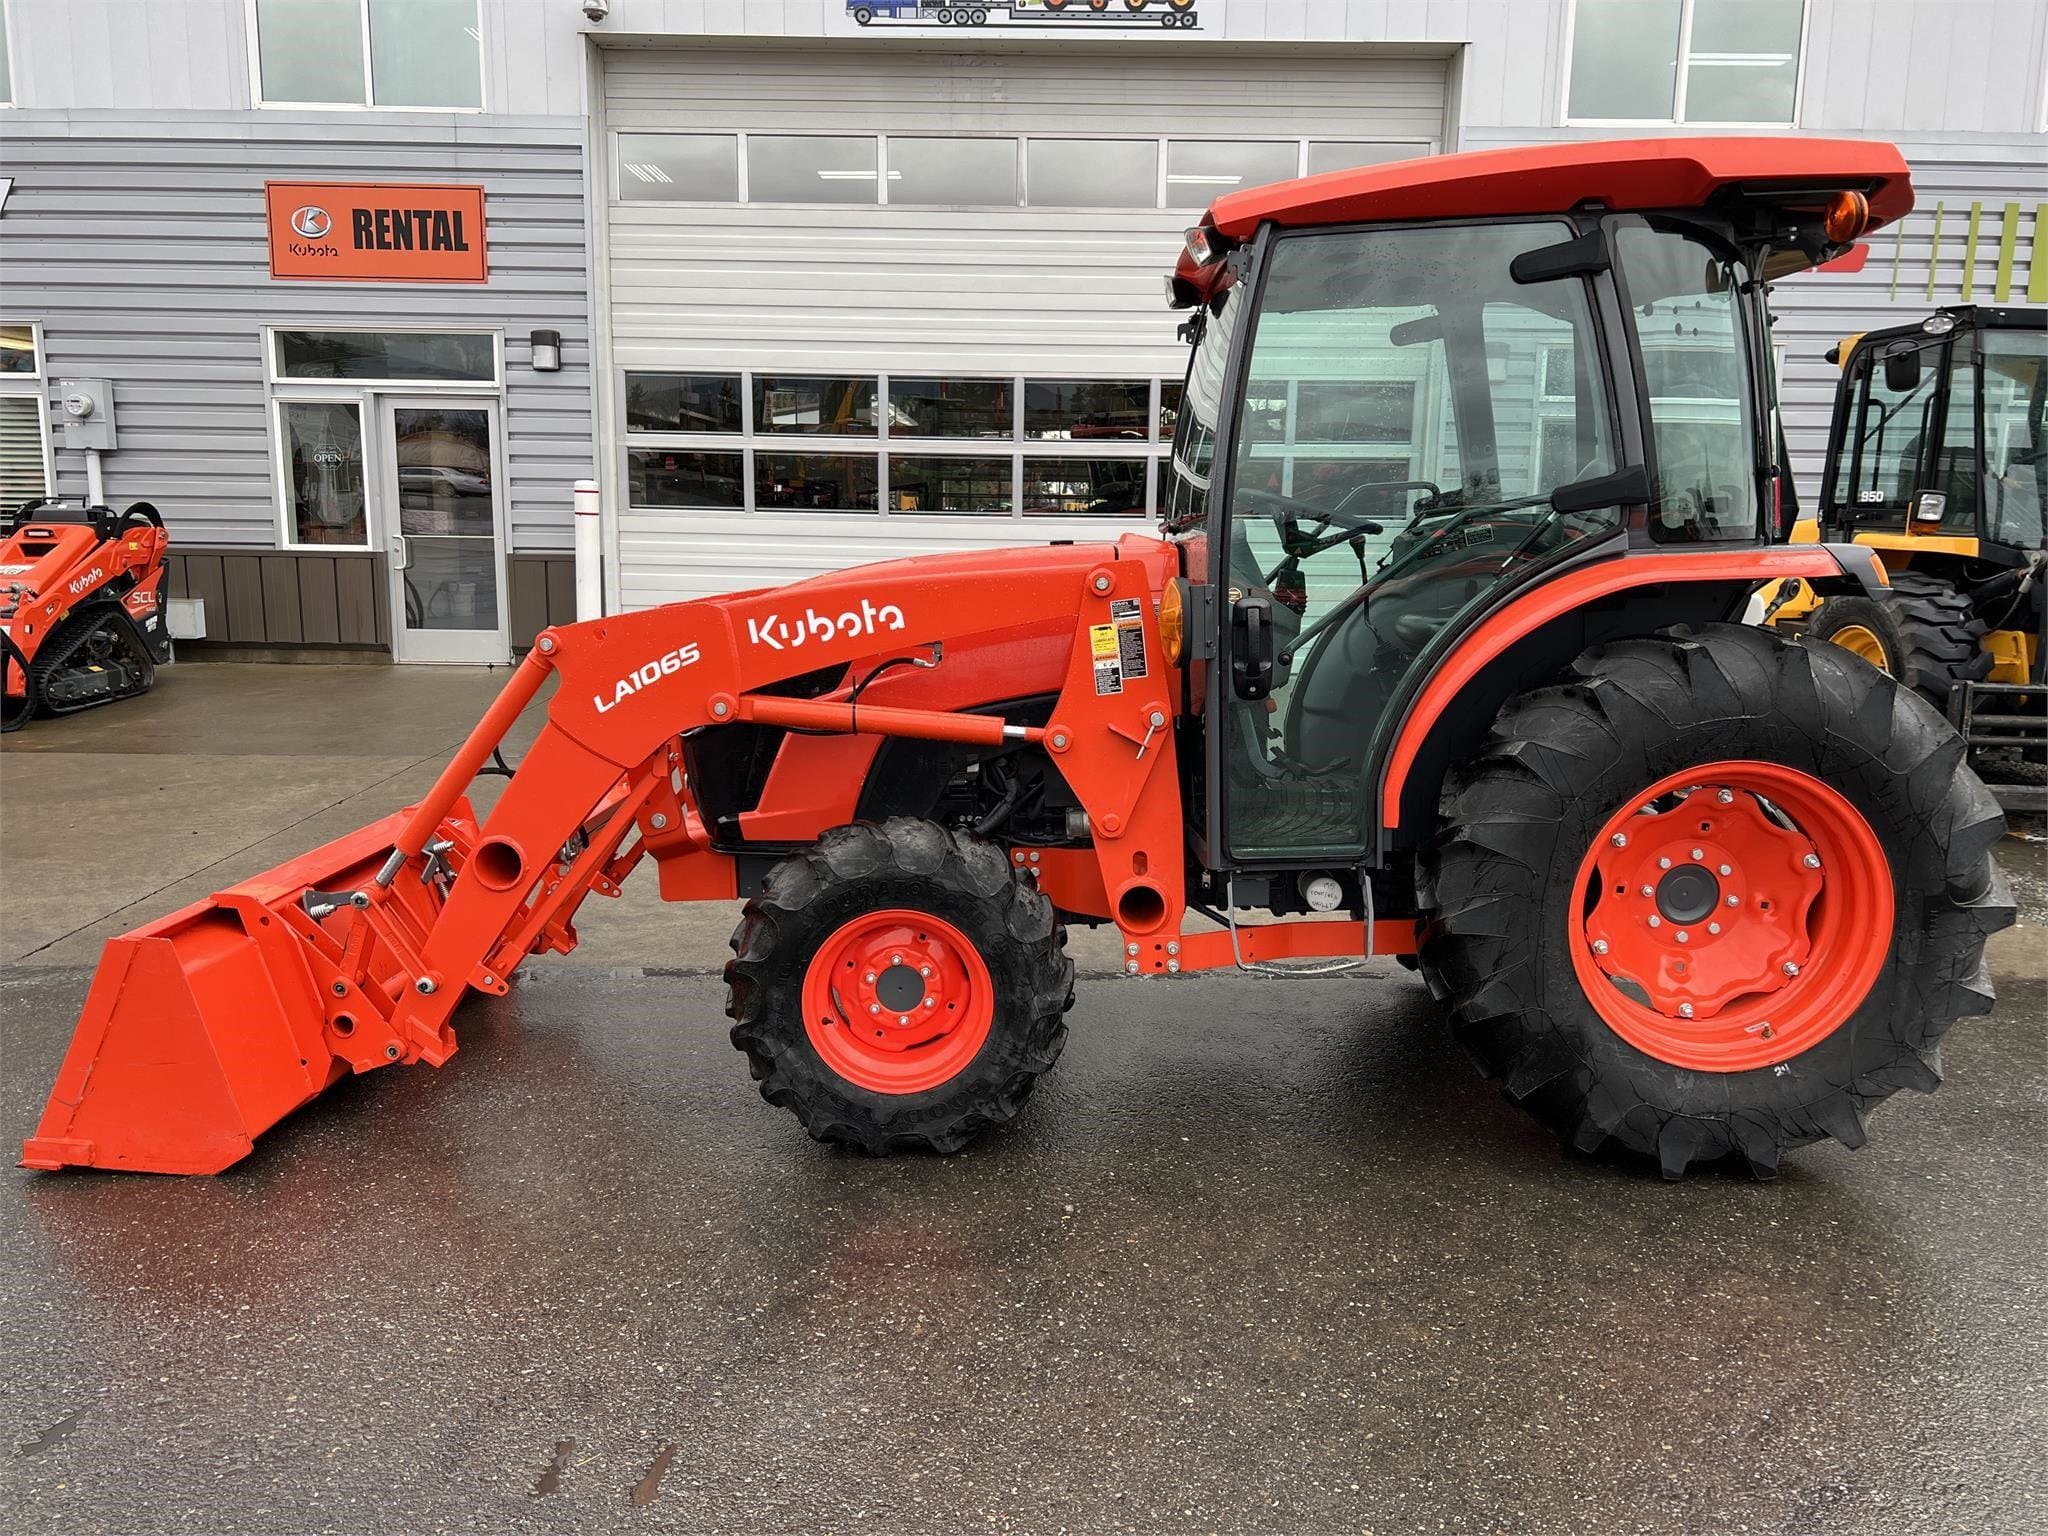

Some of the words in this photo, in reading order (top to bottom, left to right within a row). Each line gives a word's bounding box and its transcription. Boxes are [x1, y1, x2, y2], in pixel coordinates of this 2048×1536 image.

[352, 208, 469, 251] RENTAL
[289, 243, 338, 257] Kubota
[313, 453, 342, 463] OPEN
[1860, 491, 1884, 502] 950
[69, 567, 103, 594] Kubota
[132, 591, 155, 604] SCL
[747, 599, 905, 650] Kubota
[593, 642, 701, 714] LA1065
